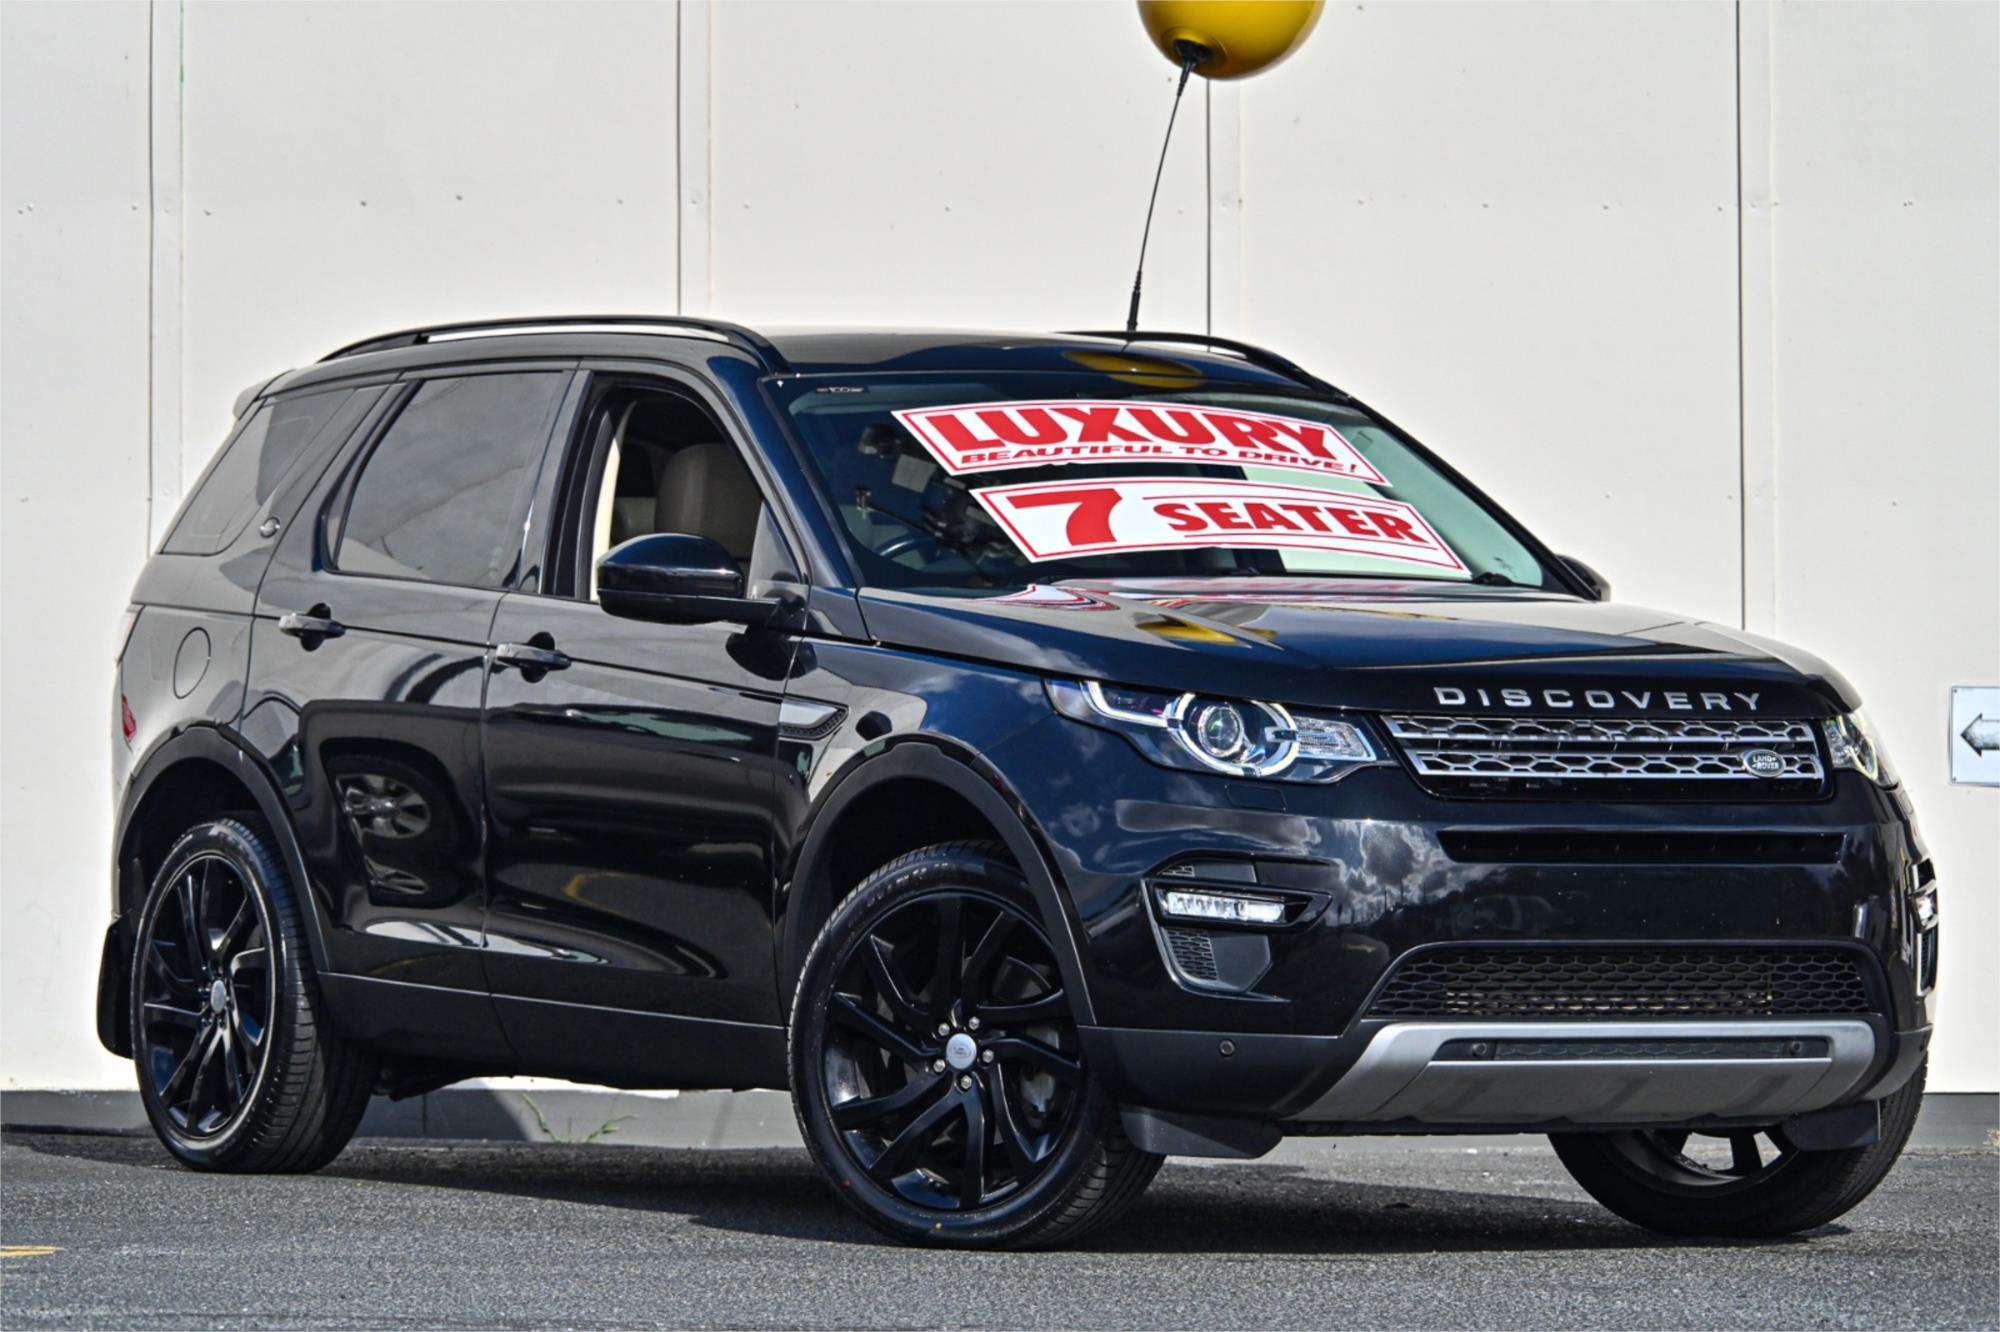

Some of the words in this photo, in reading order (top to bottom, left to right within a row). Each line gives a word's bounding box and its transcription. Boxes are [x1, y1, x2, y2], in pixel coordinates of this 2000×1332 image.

[925, 407, 1338, 460] LUXURY
[961, 445, 1173, 465] BEAUTIFUL
[1179, 446, 1228, 457] TO
[1006, 488, 1122, 546] 7
[1153, 501, 1429, 544] SEATER
[1433, 686, 1760, 711] DISCOVERY
